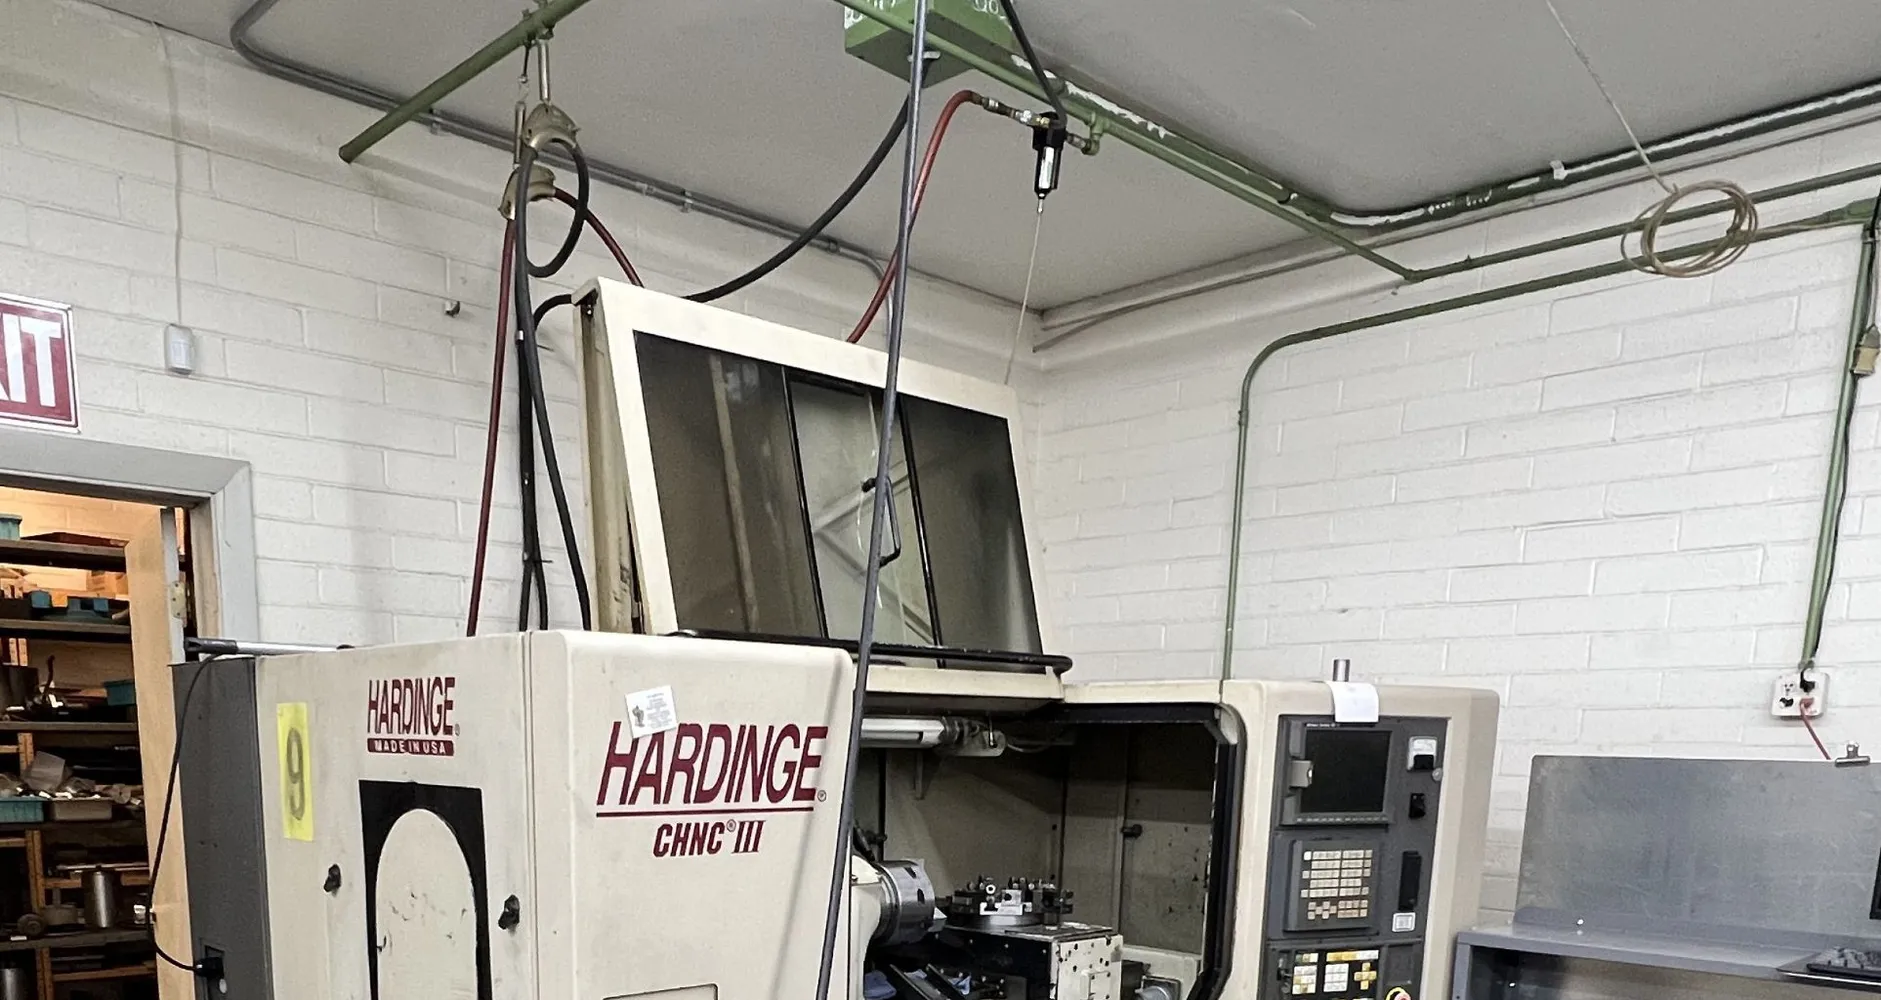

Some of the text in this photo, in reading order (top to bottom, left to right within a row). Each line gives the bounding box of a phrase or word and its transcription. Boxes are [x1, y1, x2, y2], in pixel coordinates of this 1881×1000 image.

[0, 311, 62, 408] IT
[286, 726, 306, 821] 9
[374, 739, 447, 755] MADE IN USA
